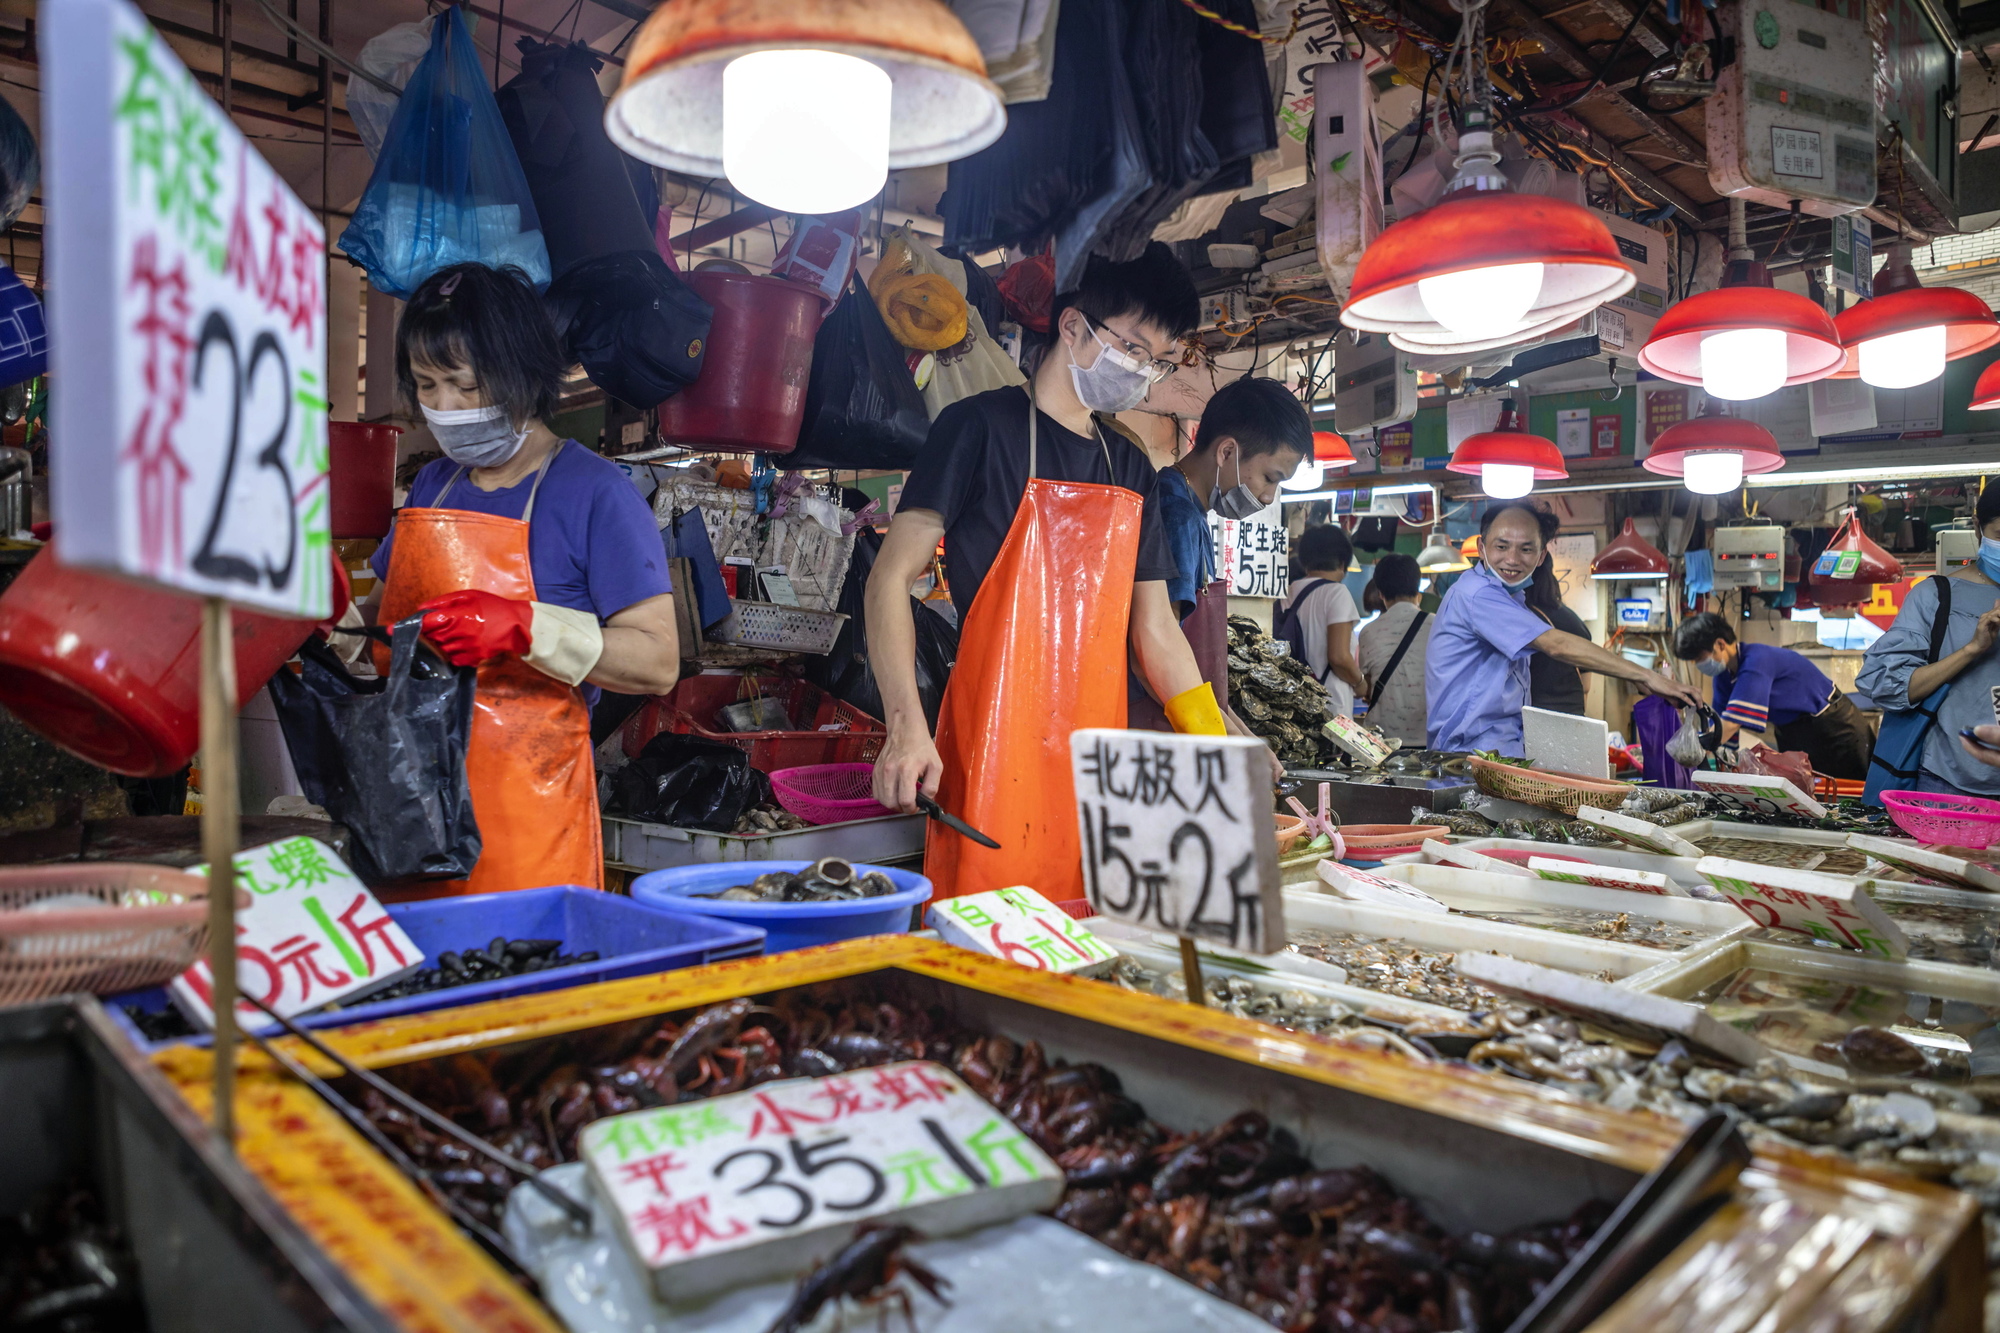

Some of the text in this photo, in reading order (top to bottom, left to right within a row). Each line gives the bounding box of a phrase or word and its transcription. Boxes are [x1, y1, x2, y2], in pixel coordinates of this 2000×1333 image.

[1774, 133, 1819, 153] 沙园市场
[1781, 155, 1815, 173] 专用秤
[1236, 520, 1287, 556] 肥生蚝
[1237, 548, 1288, 597] 5元1只
[1081, 736, 1241, 824] 北极贝
[1082, 801, 1262, 950] 15元2斤
[950, 888, 1047, 928] 白贝
